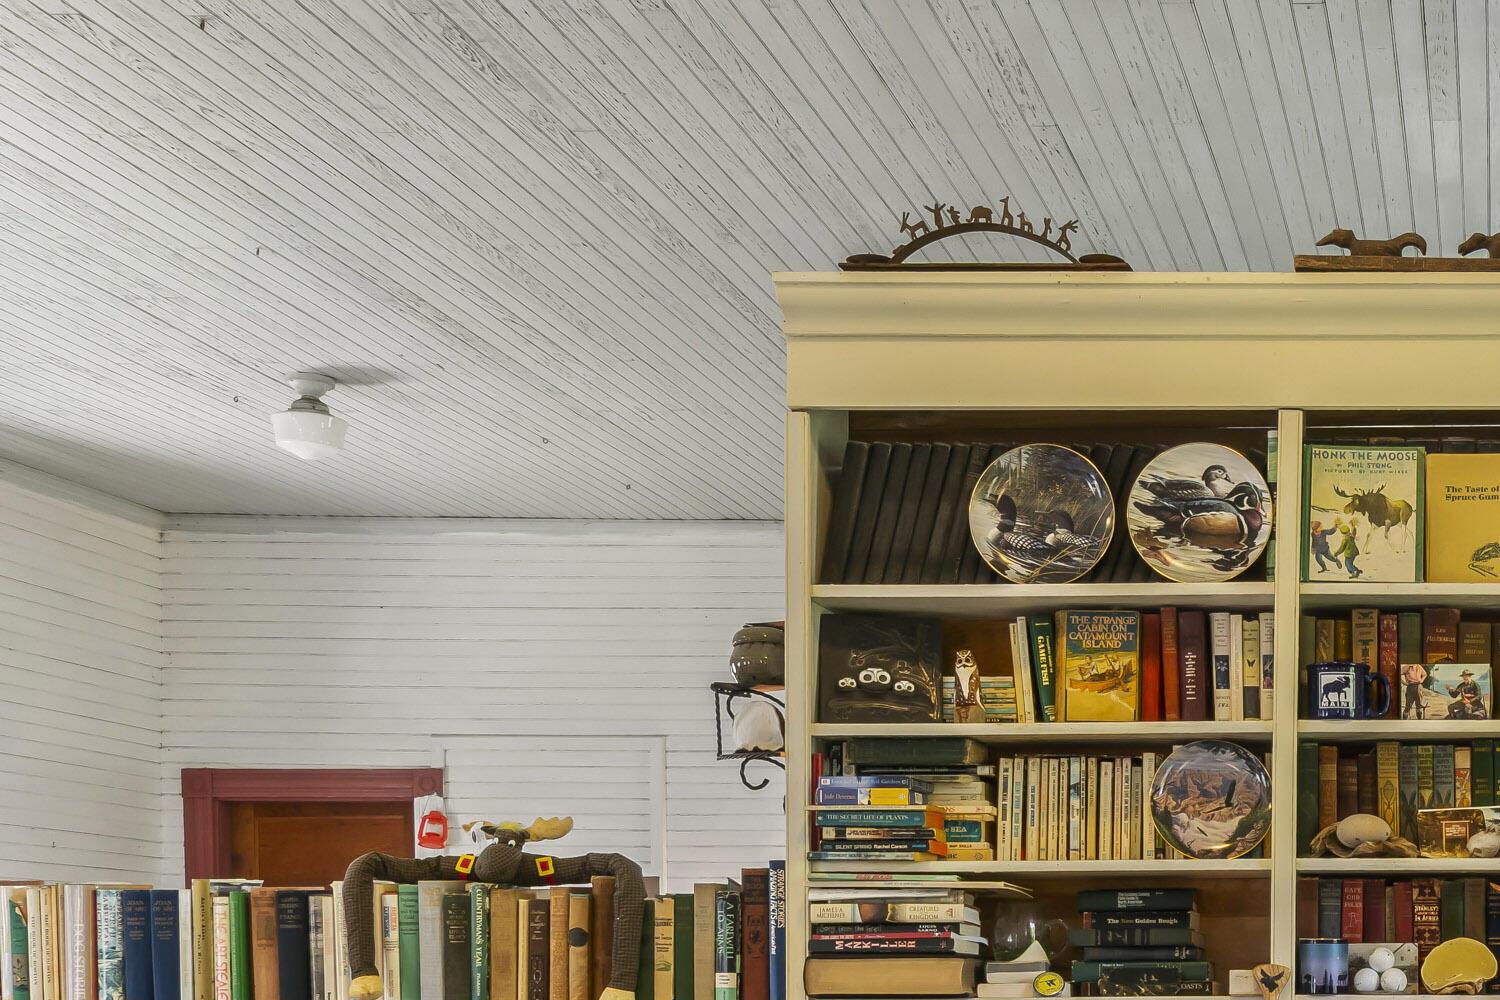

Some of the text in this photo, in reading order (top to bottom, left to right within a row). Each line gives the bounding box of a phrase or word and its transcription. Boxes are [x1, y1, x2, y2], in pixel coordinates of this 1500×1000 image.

[1313, 450, 1416, 461] HONK THE MOOSE
[1445, 494, 1476, 502] Spruce
[1070, 616, 1136, 625] THE STRANGE
[1077, 624, 1127, 632] CABIN ON
[1069, 632, 1133, 641] CATAMOUNT
[1081, 640, 1121, 649] ISLAND
[777, 869, 785, 928] STRANGE STORIES
[726, 912, 734, 959] FAREWELL
[835, 940, 916, 950] MANKILLER
